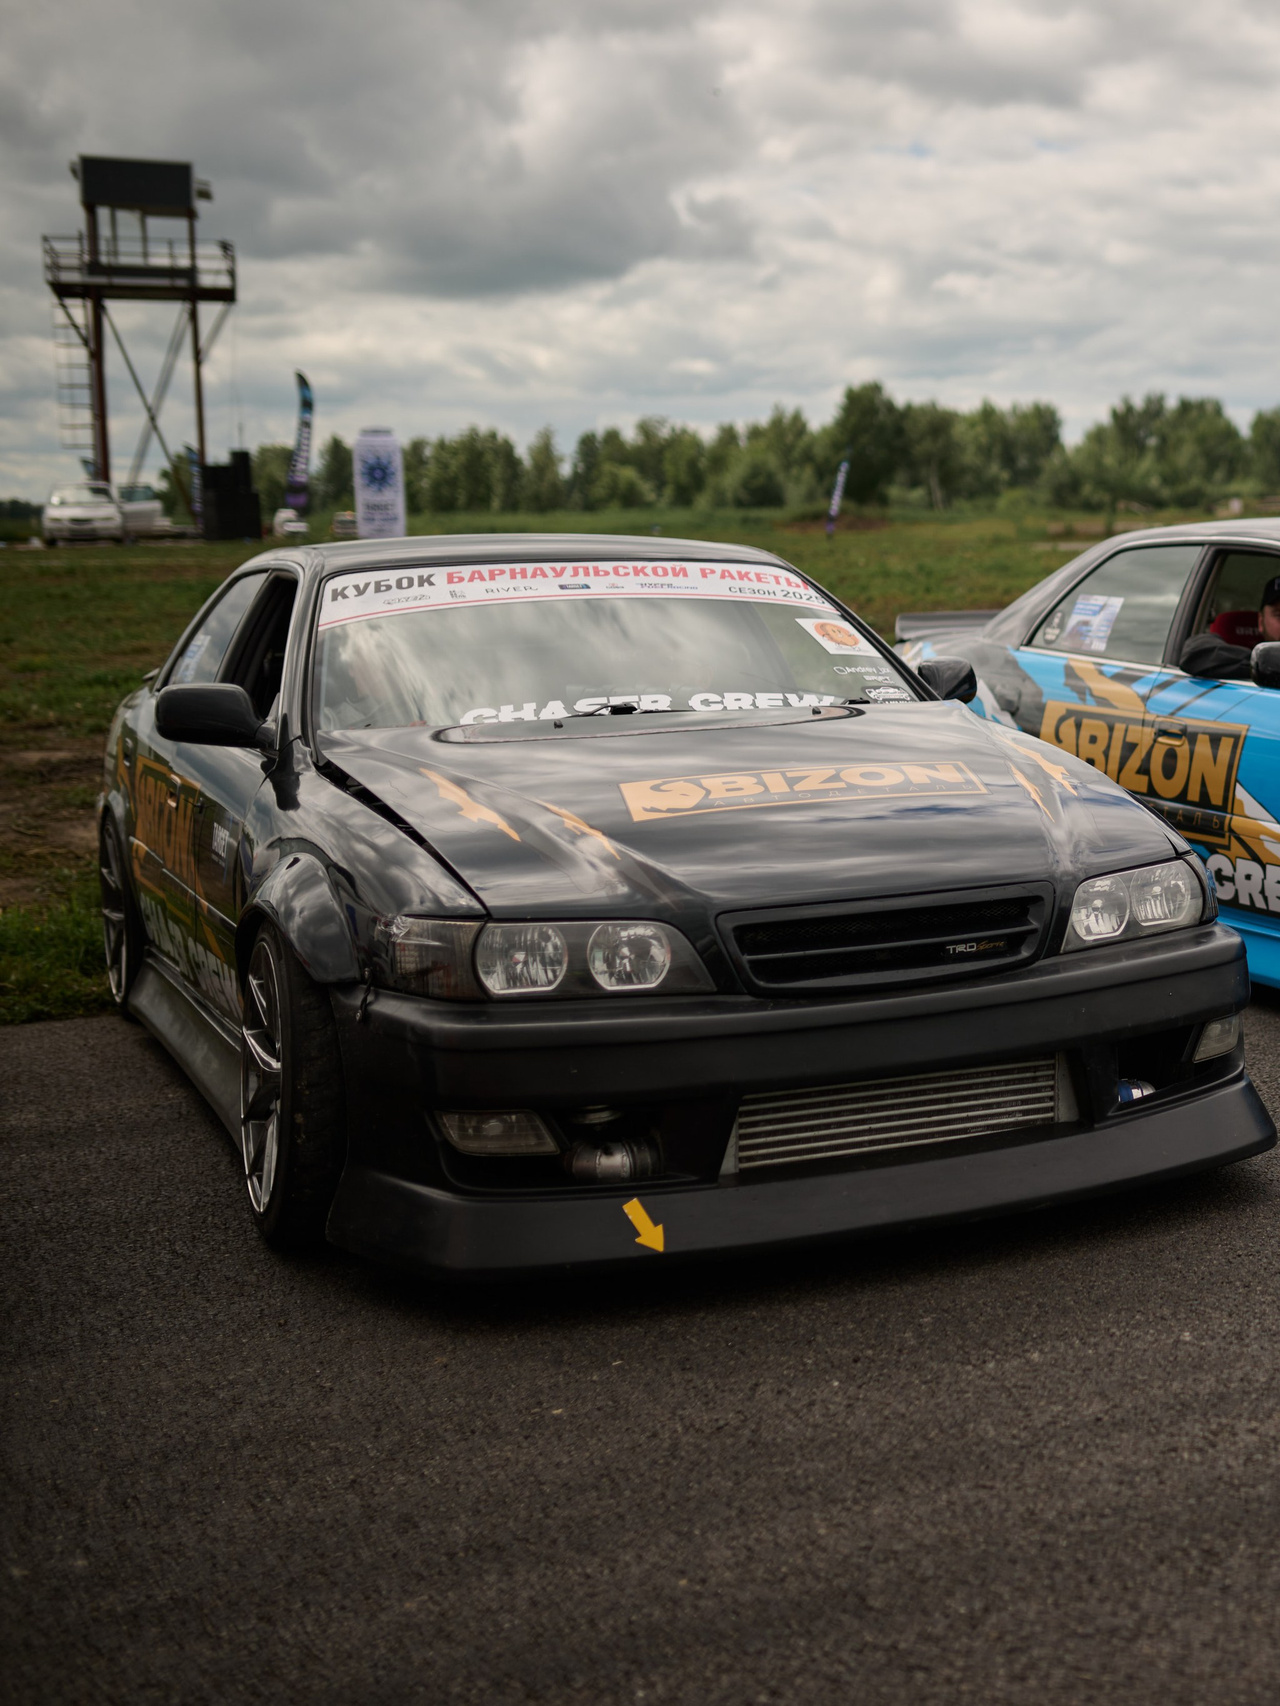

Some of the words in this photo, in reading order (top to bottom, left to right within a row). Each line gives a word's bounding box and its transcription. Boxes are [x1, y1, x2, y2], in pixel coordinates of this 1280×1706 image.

[330, 573, 436, 602] КУБОК
[446, 563, 689, 585] БАРНАУЛЬСКОЙ
[699, 567, 810, 591] РАКЕТЫ
[728, 586, 777, 597] СЕЗОН
[781, 589, 827, 605] 2025
[687, 692, 836, 712] CREW
[1078, 718, 1235, 807] BIZON
[701, 764, 966, 799] BIZON
[714, 784, 974, 806] АВТОДЕТАЛЬ
[946, 942, 976, 954] TRD
